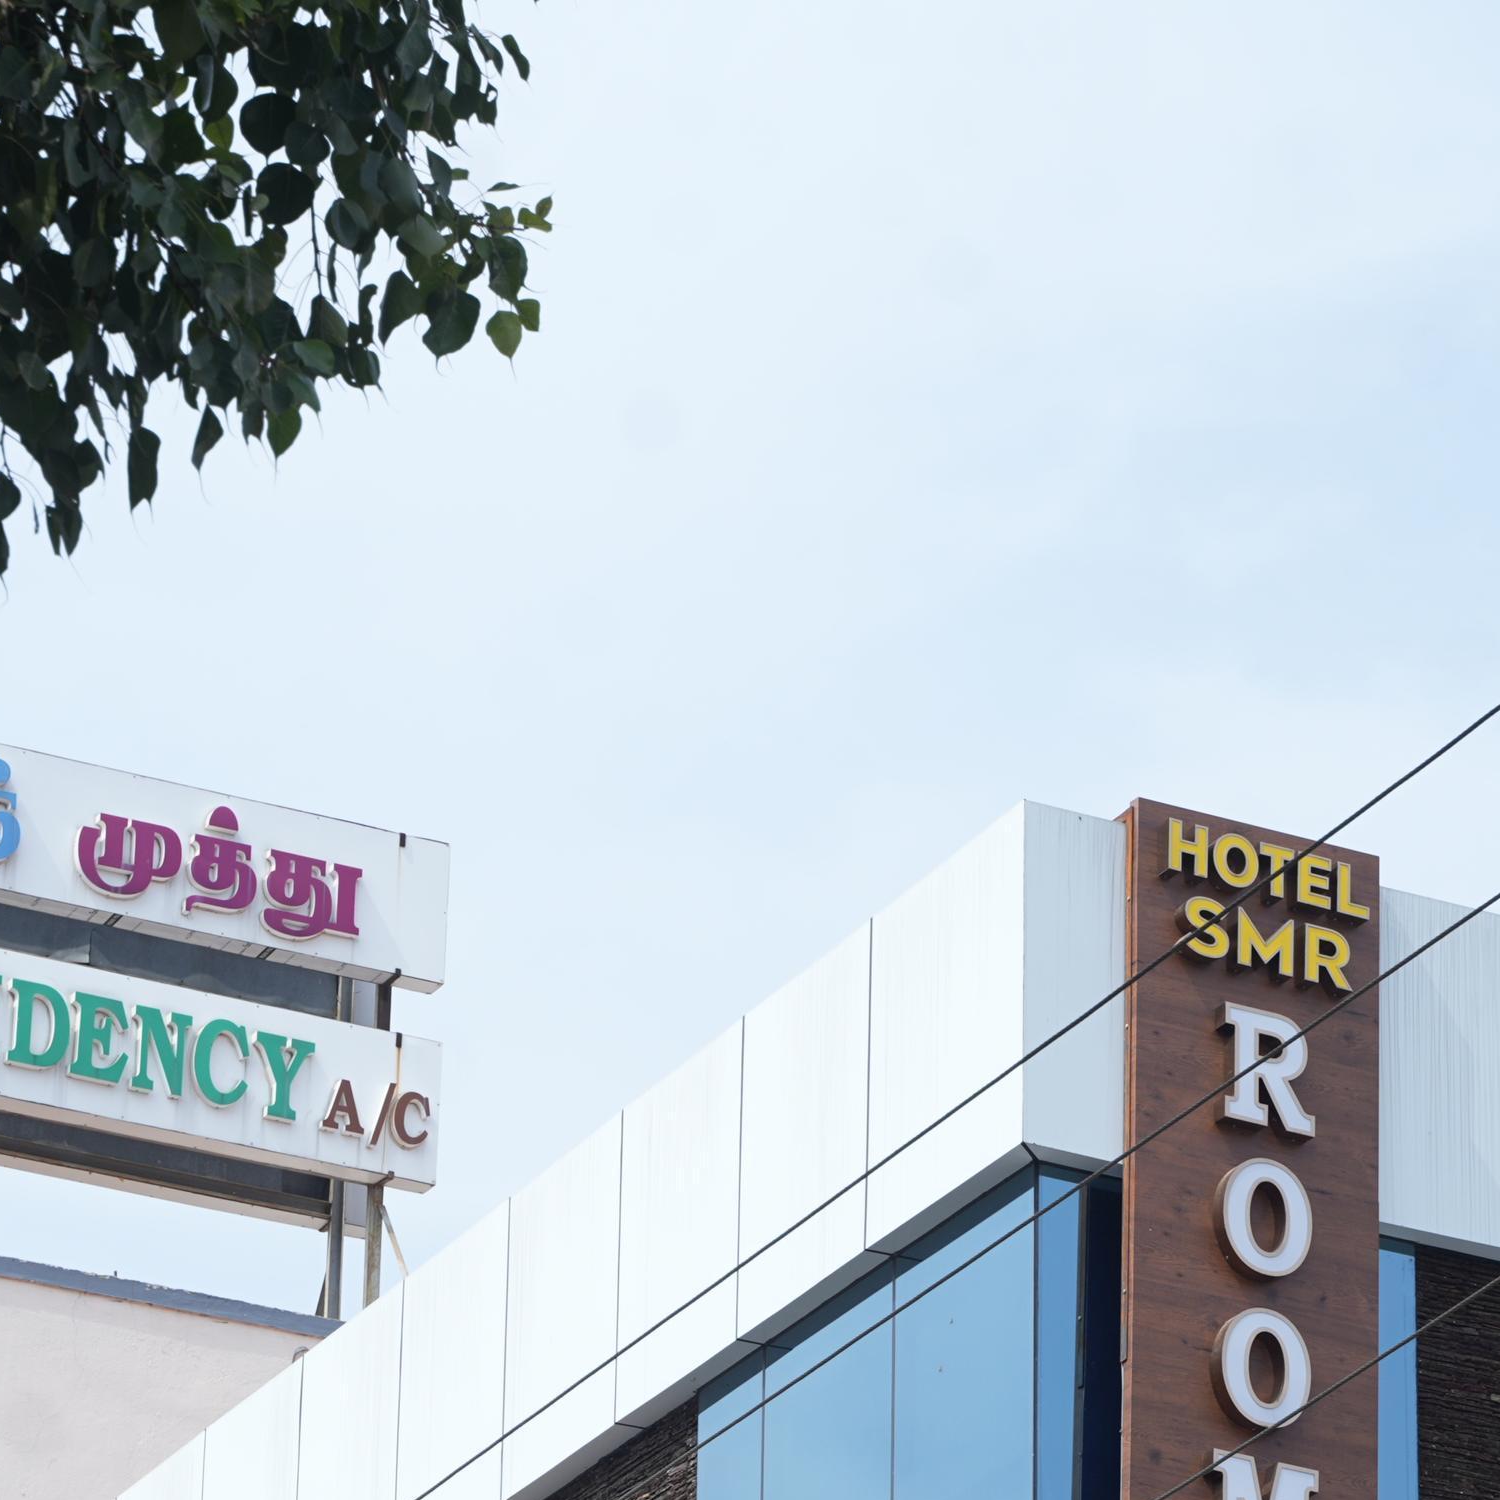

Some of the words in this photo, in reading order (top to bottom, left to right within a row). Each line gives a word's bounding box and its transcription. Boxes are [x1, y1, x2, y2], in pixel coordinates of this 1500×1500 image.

[74, 805, 363, 941] முத்து
[1165, 817, 1370, 921] HOTEL
[1178, 896, 1353, 992] SMR
[320, 1078, 431, 1149] A/C
